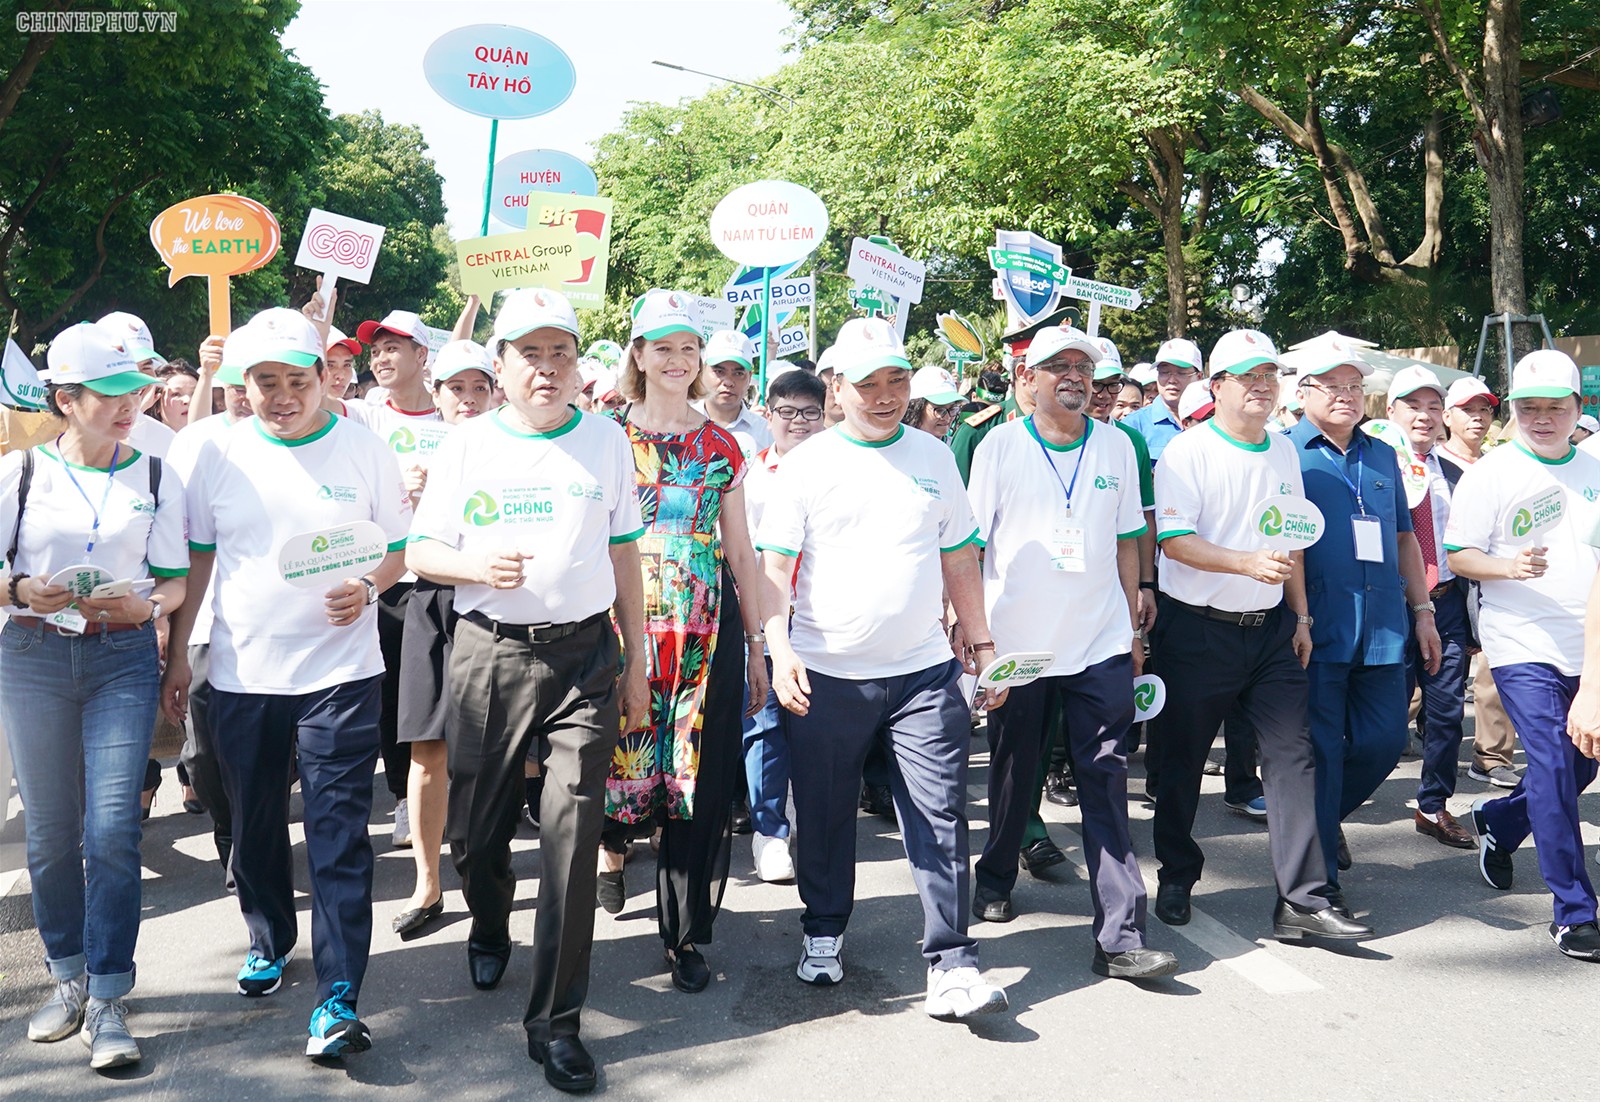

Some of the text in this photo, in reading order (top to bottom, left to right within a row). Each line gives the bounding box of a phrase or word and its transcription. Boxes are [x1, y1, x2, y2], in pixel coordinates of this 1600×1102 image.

[475, 46, 528, 67] QUẬN
[467, 72, 531, 94] TÂY HỒ
[520, 169, 561, 186] HUYỆN
[748, 200, 788, 218] QUẬN
[179, 208, 245, 234] We love
[723, 225, 813, 242] NAM TỪ LIÊM
[172, 237, 260, 256] the EARTH
[308, 224, 374, 269] GO!
[465, 244, 572, 267] CENTRAL Group
[491, 262, 550, 278] VIETNAM
[858, 249, 922, 285] CENTRAL Group
[871, 267, 906, 288] VIETNAM
[1012, 274, 1045, 291] aneco
[772, 296, 812, 306] AIRWAYS
[1285, 519, 1316, 534] CHỐNG
[284, 570, 304, 580] PHONG
